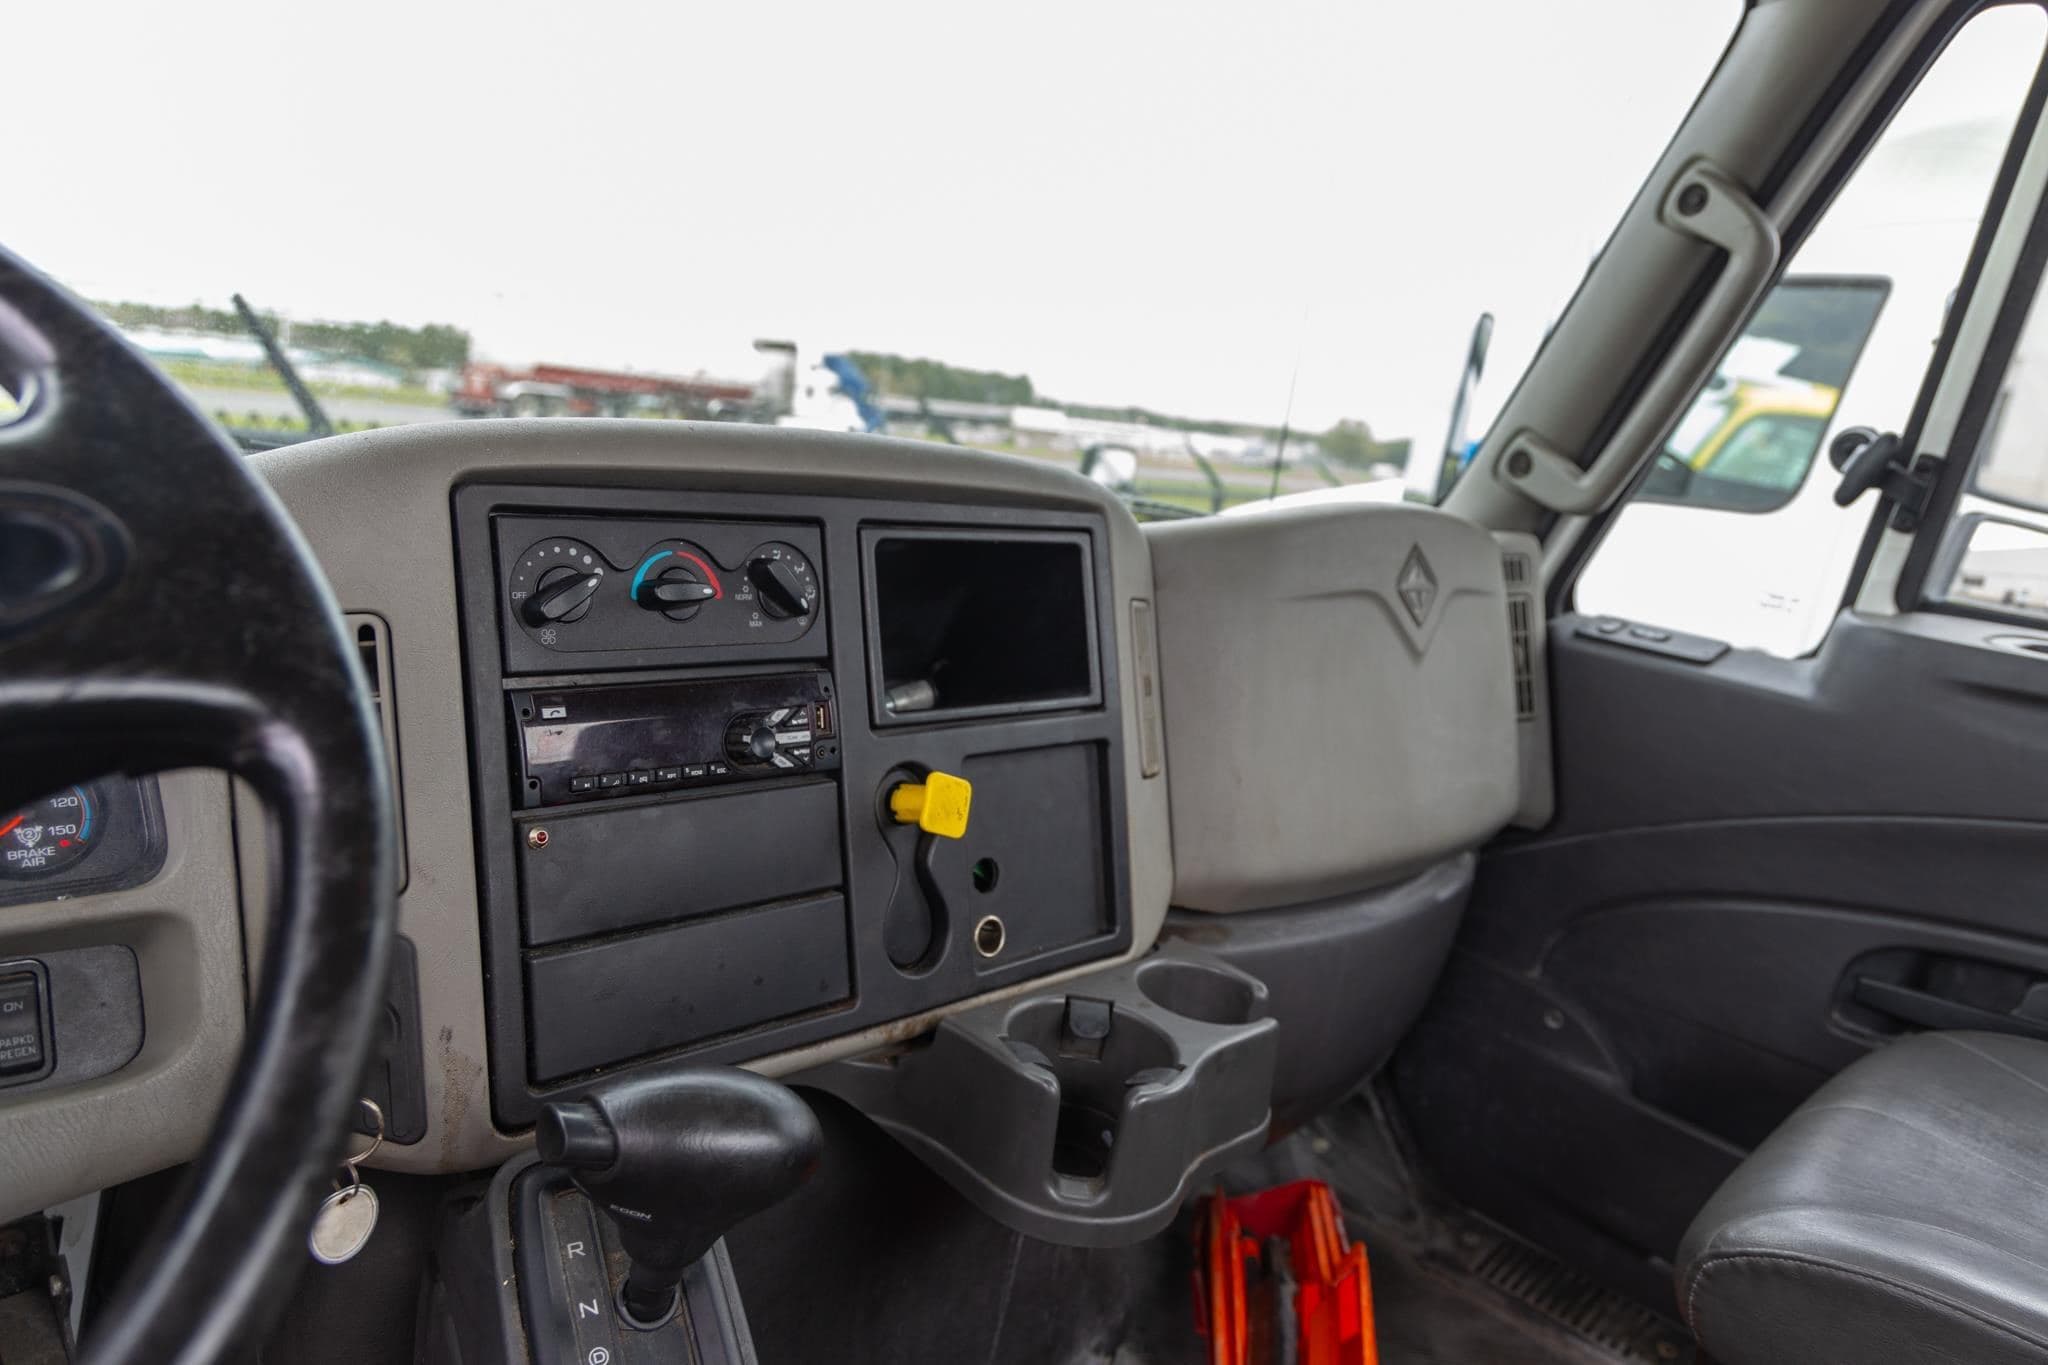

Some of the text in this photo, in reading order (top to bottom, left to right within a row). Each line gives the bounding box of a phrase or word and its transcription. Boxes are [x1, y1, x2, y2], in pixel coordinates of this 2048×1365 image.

[49, 796, 79, 808] 120
[48, 824, 77, 836] 150
[7, 846, 57, 861] BRAKE
[21, 857, 46, 868] AIR
[3, 1000, 24, 1013] ON
[0, 1046, 37, 1060] REGEN
[567, 1241, 586, 1259] R
[579, 1299, 600, 1318] N
